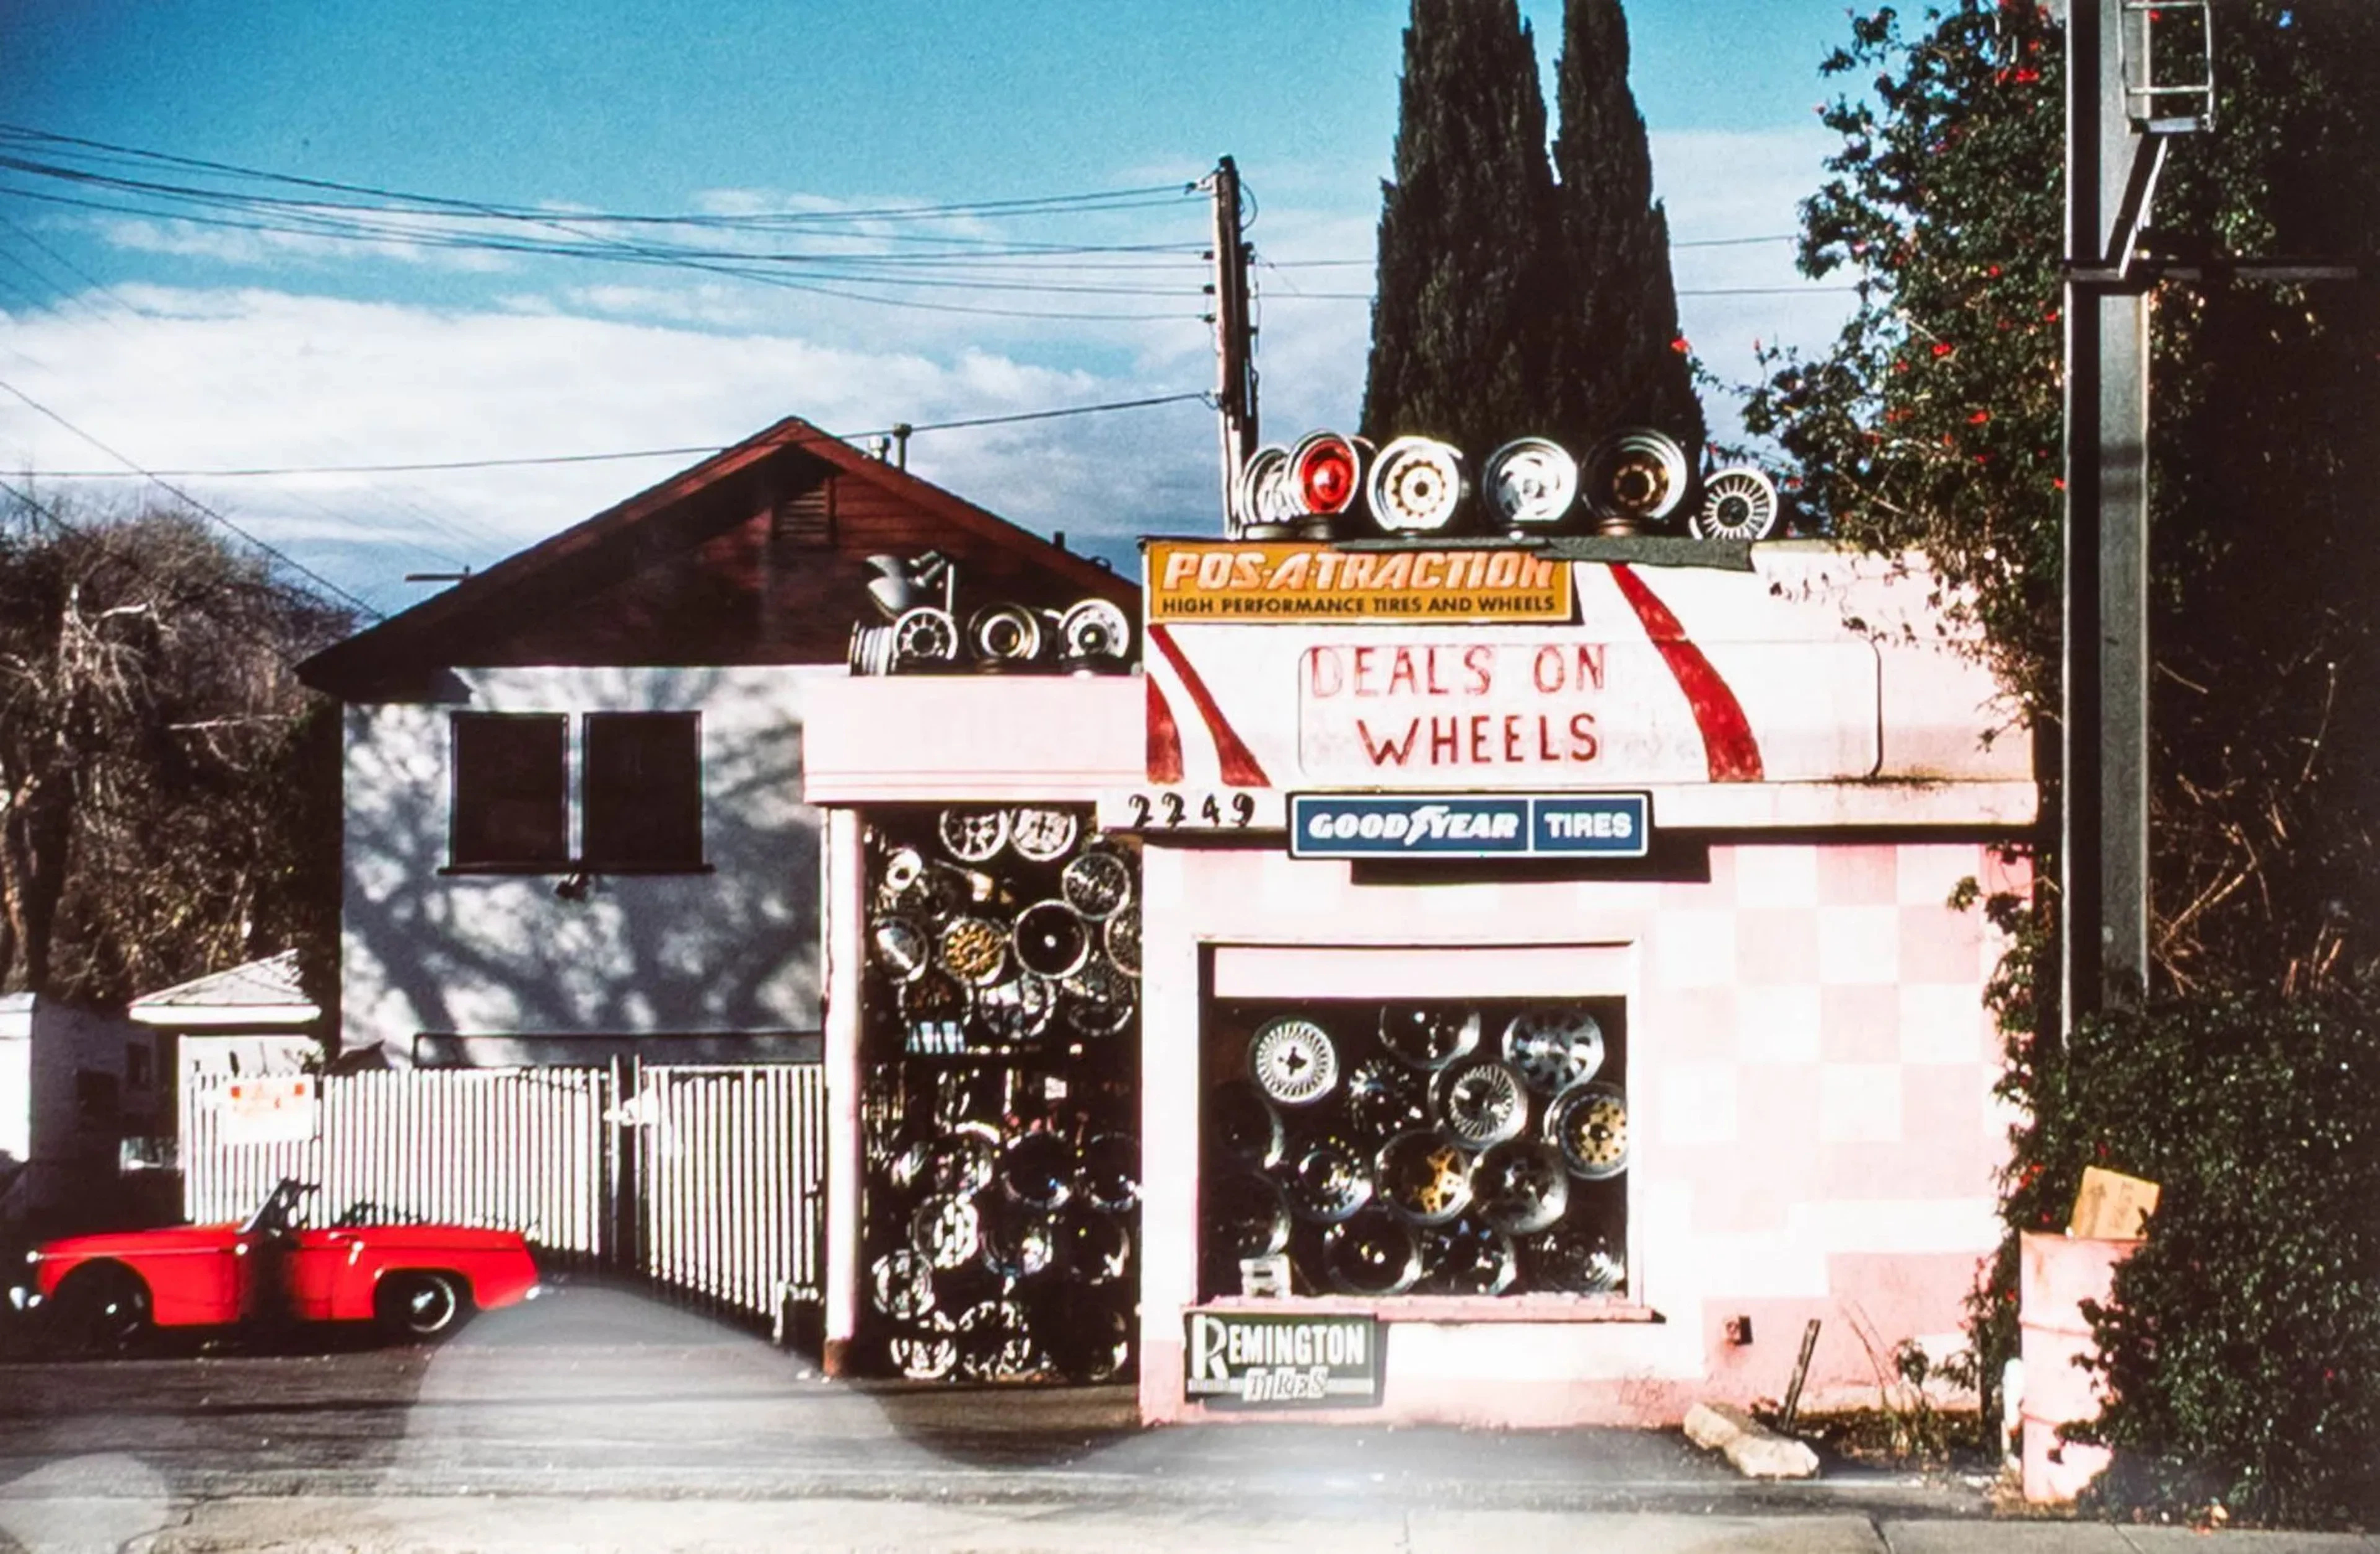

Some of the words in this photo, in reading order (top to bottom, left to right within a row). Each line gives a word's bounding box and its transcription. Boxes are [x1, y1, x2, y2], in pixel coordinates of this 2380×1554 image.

[1163, 597, 1213, 613] HIGH
[1222, 596, 1364, 613] PERFORMANCE
[1373, 597, 1422, 612] TIRES
[1427, 597, 1472, 612] AND
[1477, 595, 1555, 612] WHEELS
[1310, 644, 1492, 698] DEALS
[1533, 643, 1605, 693] ON
[1357, 713, 1598, 766] WHEELS
[1128, 792, 1255, 829] 2249
[1308, 806, 1521, 846] GOODYEAR
[1544, 812, 1632, 839] TIRES
[1192, 1314, 1365, 1381] REMINGTON
